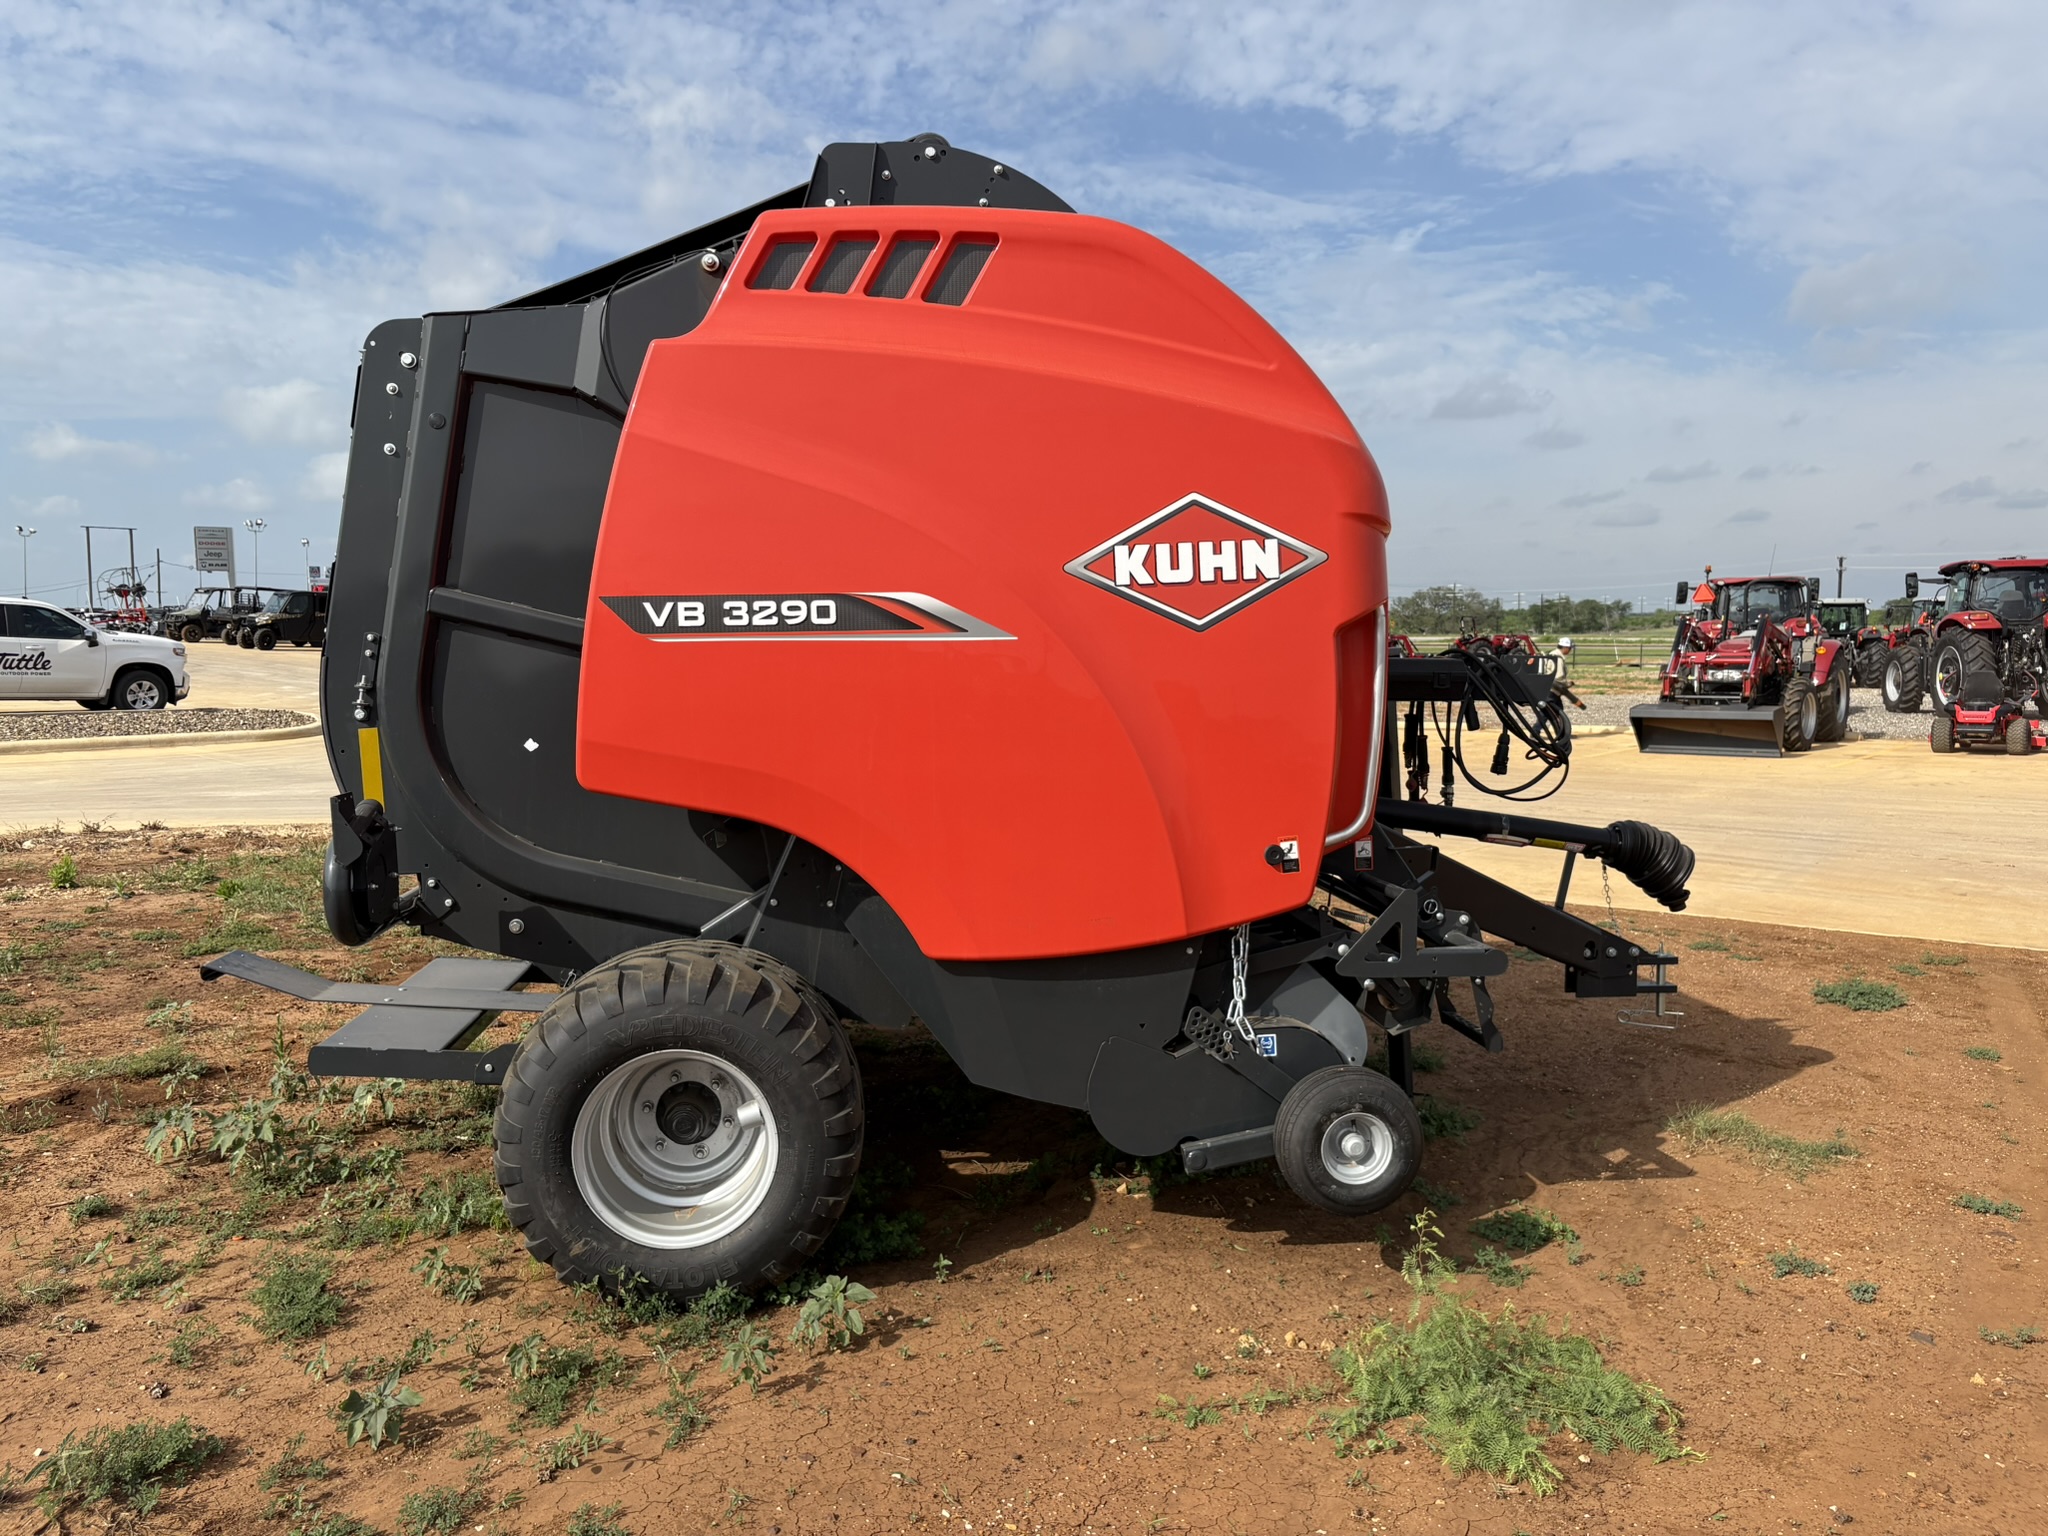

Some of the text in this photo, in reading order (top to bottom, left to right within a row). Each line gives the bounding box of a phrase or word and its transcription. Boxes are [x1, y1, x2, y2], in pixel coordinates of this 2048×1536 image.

[204, 550, 223, 558] Jeep
[1113, 538, 1281, 586] KUHN
[643, 600, 838, 628] VB 3290
[0, 651, 52, 670] Tuttle
